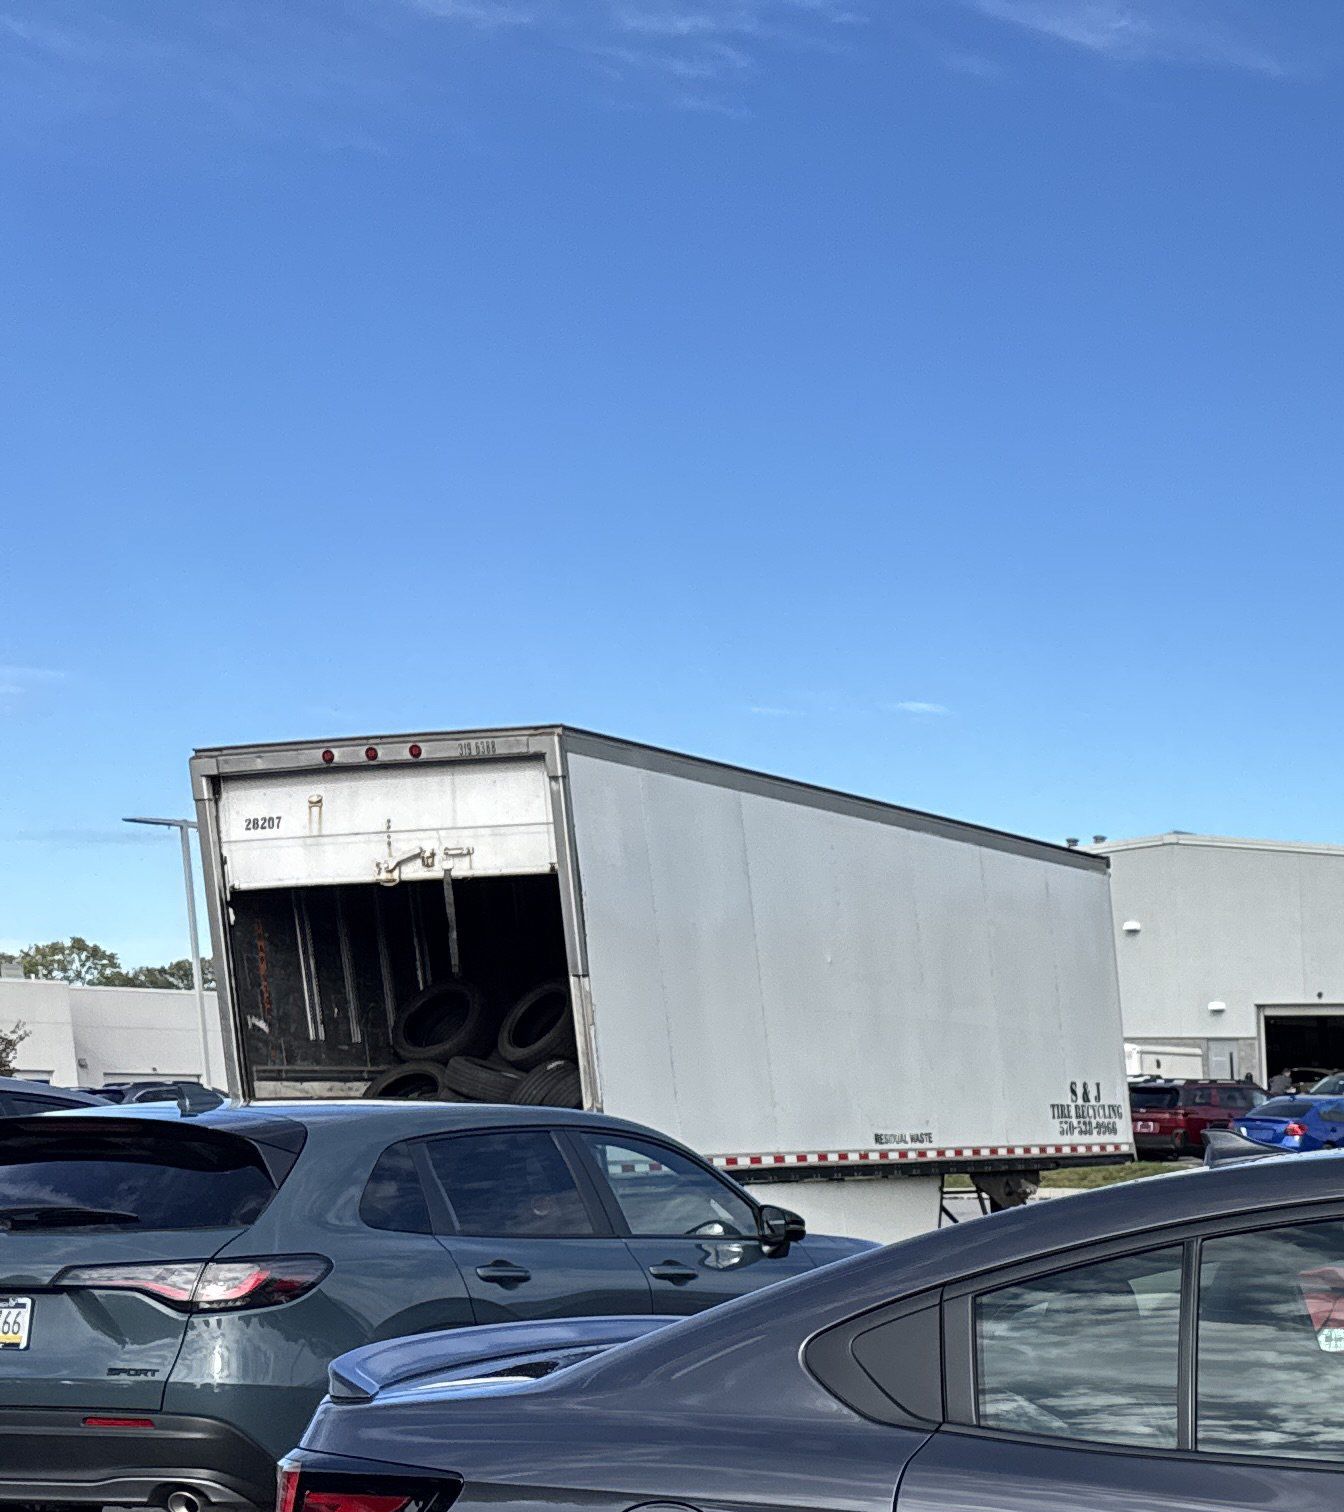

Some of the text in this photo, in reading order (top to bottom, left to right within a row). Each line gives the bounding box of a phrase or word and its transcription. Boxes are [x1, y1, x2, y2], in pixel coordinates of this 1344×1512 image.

[244, 815, 282, 831] 28207
[1069, 1080, 1102, 1103] S & J
[1050, 1104, 1123, 1120] TIRE RECYCLING
[106, 1367, 160, 1377] SPORT
